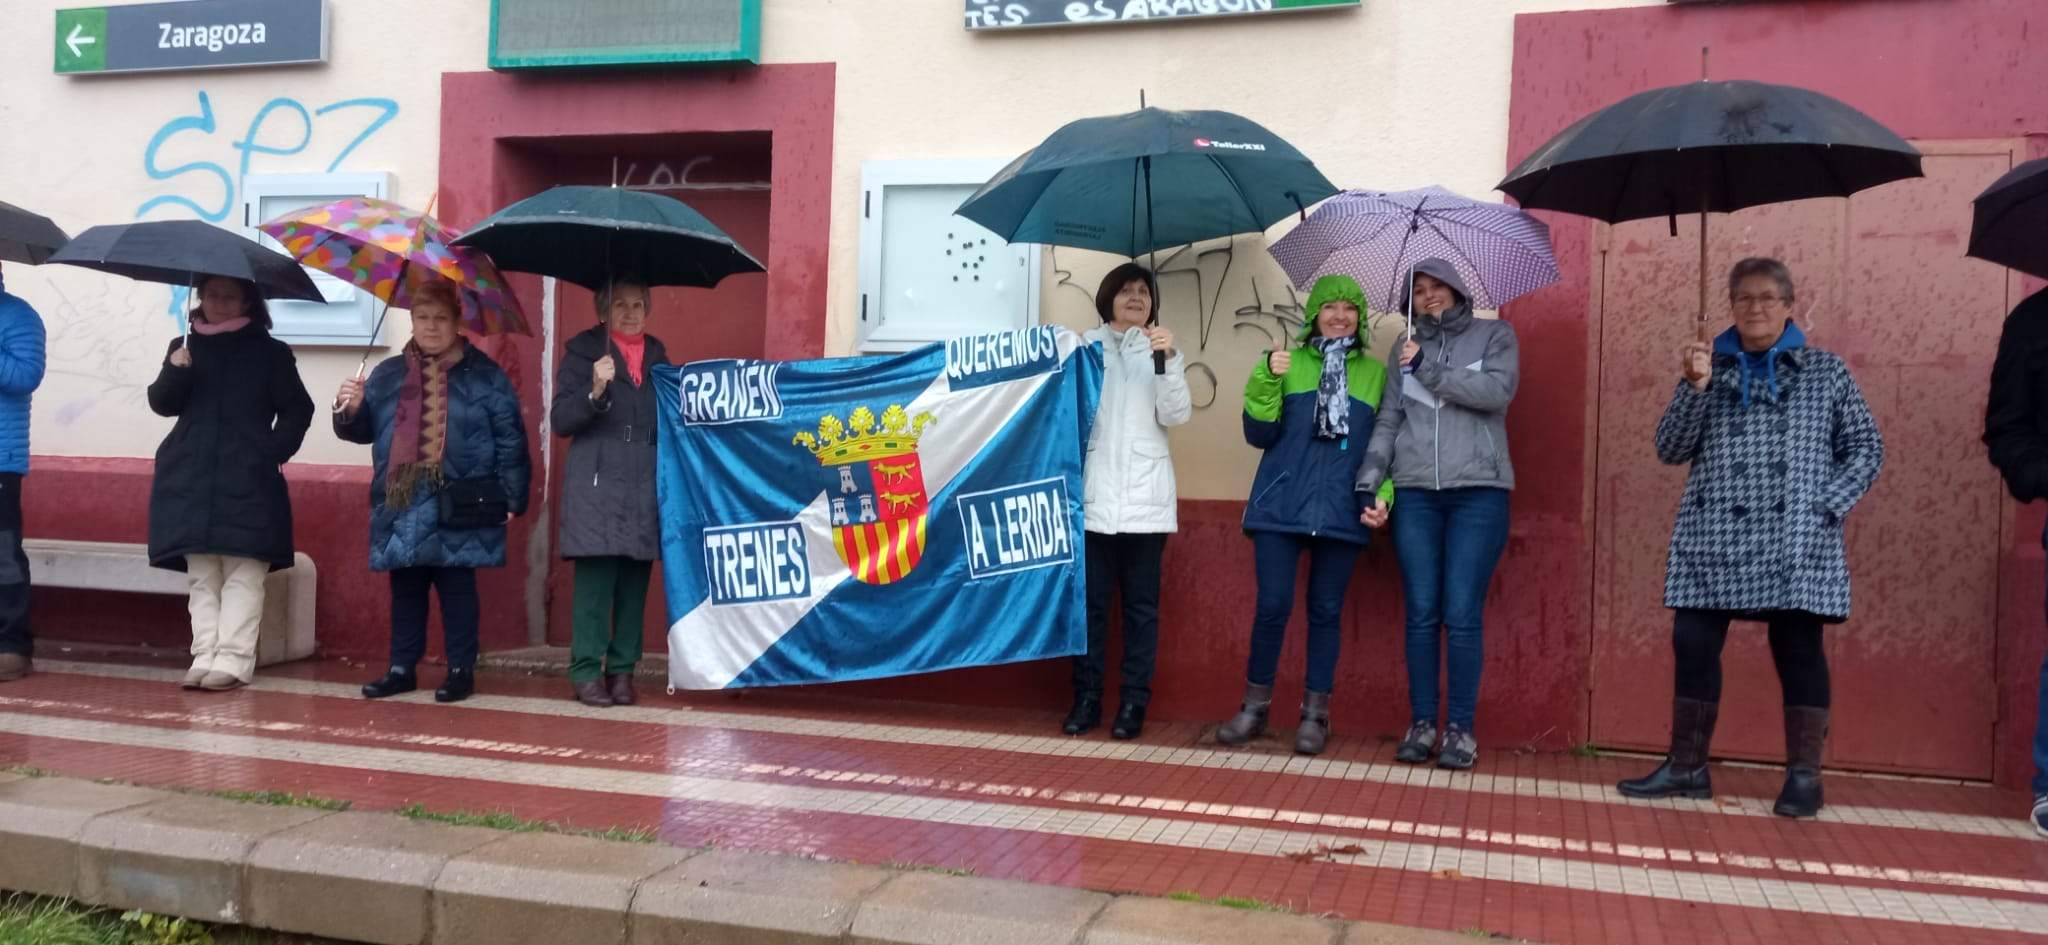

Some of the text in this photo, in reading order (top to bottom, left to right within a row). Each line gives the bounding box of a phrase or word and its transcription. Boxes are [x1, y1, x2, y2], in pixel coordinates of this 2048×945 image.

[158, 22, 266, 50] Zaragoza
[947, 326, 1054, 380] QUEREMOS
[681, 359, 780, 421] GRAÑÉN
[969, 488, 1069, 569] A LERIDA
[706, 526, 806, 600] TRENES
